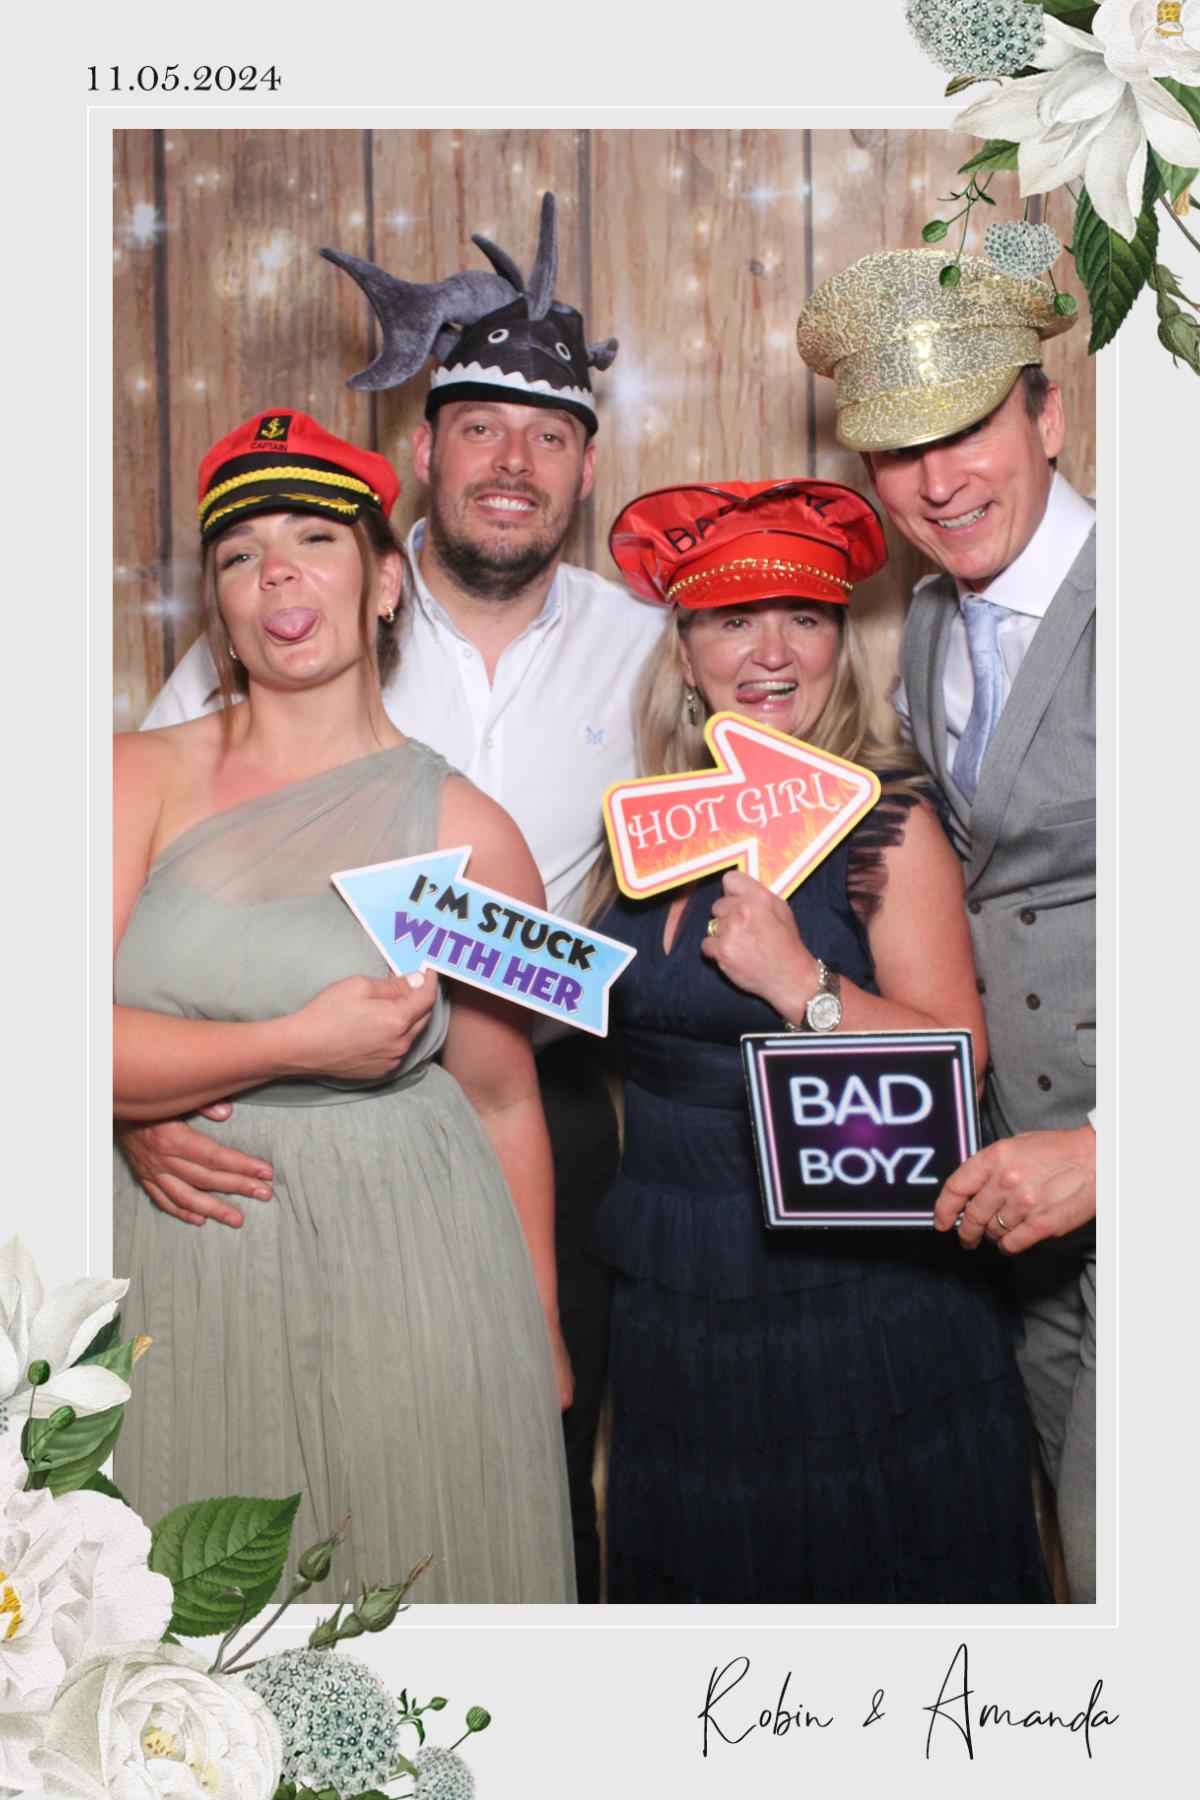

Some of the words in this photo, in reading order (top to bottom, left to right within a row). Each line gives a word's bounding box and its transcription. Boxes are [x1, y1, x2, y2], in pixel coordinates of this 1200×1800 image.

[627, 794, 726, 850] HOT
[736, 772, 842, 829] GIRL
[408, 874, 470, 921] I'M
[477, 902, 596, 972] STUCK
[394, 911, 501, 980] WITH
[502, 955, 585, 1014] HER
[789, 1074, 933, 1126] BAD
[799, 1147, 939, 1185] BOYZ
